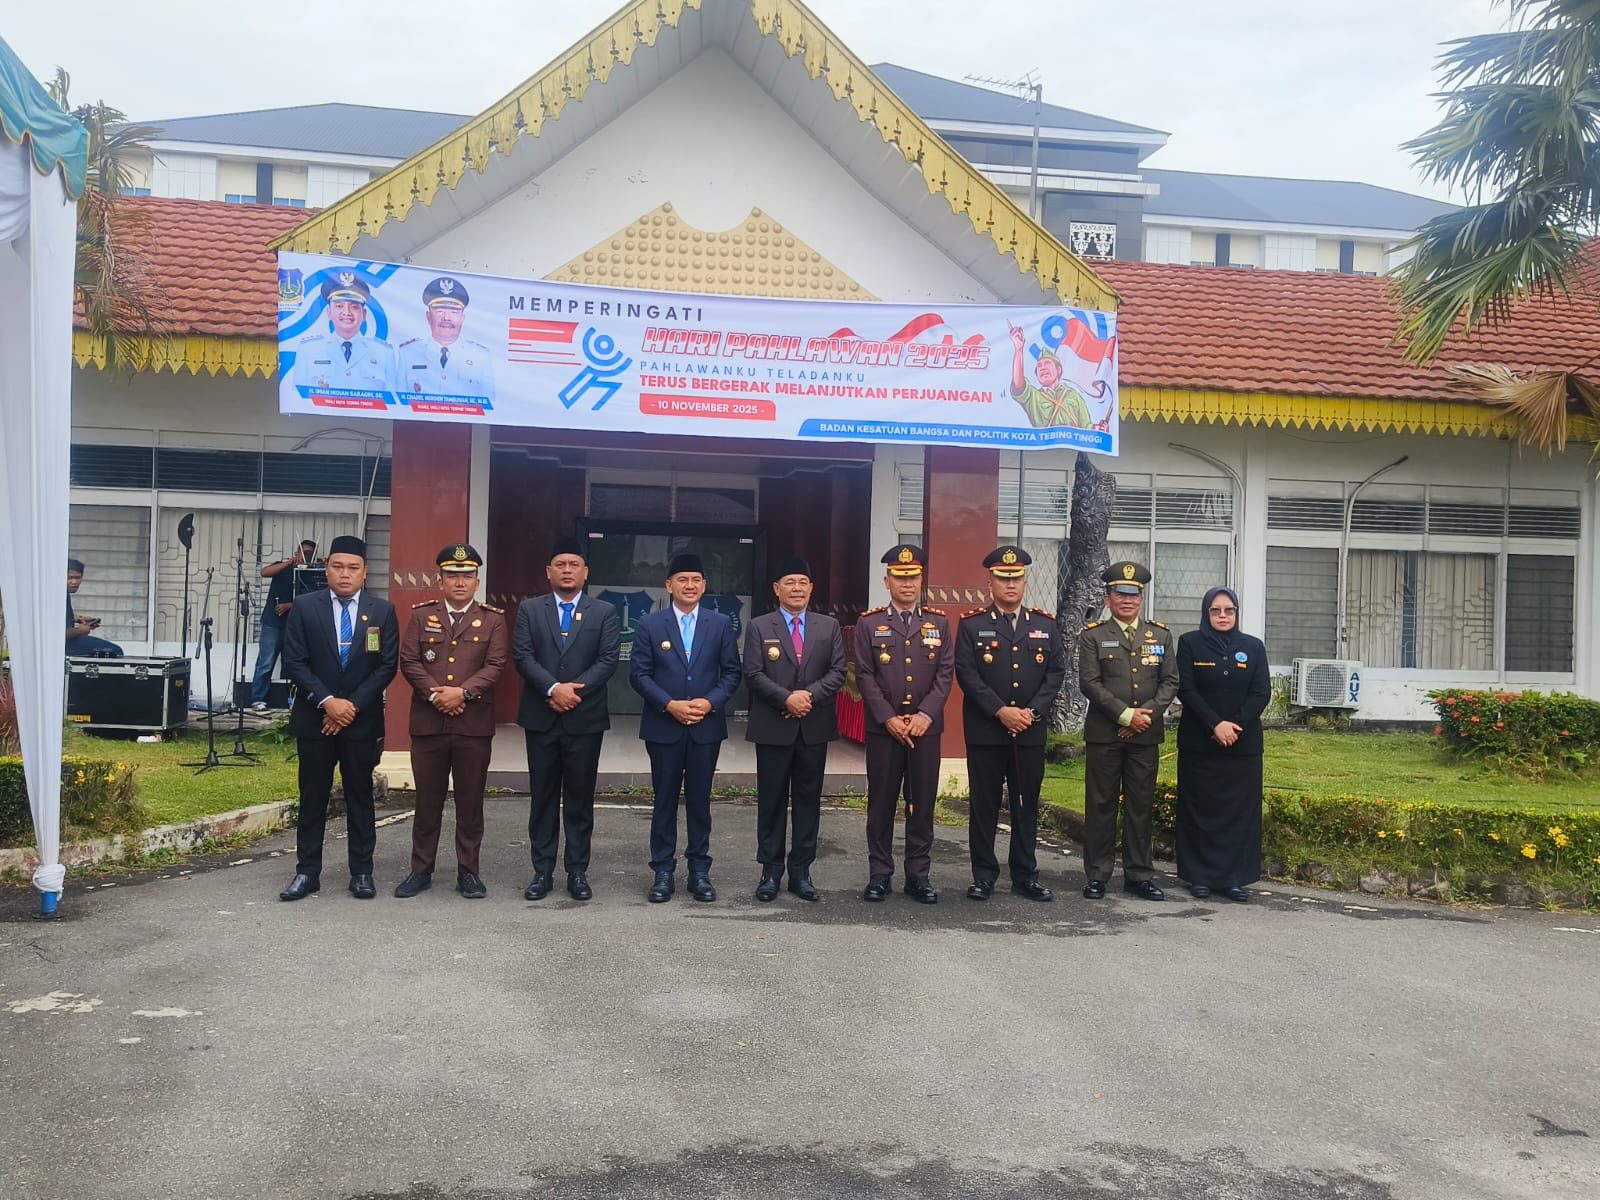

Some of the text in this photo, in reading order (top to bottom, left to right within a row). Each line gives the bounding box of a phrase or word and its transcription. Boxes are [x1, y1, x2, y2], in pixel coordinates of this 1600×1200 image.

[509, 295, 702, 322] MEMPERINGATI
[641, 327, 990, 369] HARI PAHLAWAN 2025
[640, 361, 865, 382] PAHLAWANKU TELADANKU
[640, 375, 993, 403] TERUS BERGERAK MELANJUTKAN PERJUANGAN
[658, 400, 669, 409] 10
[671, 401, 730, 413] NOVEMBER
[732, 404, 758, 414] 2025
[820, 423, 1102, 444] BADAN KESATUAN BANGSA DAN POLITIK KOTA TEBING TINGGI
[1348, 671, 1360, 702] AUX
